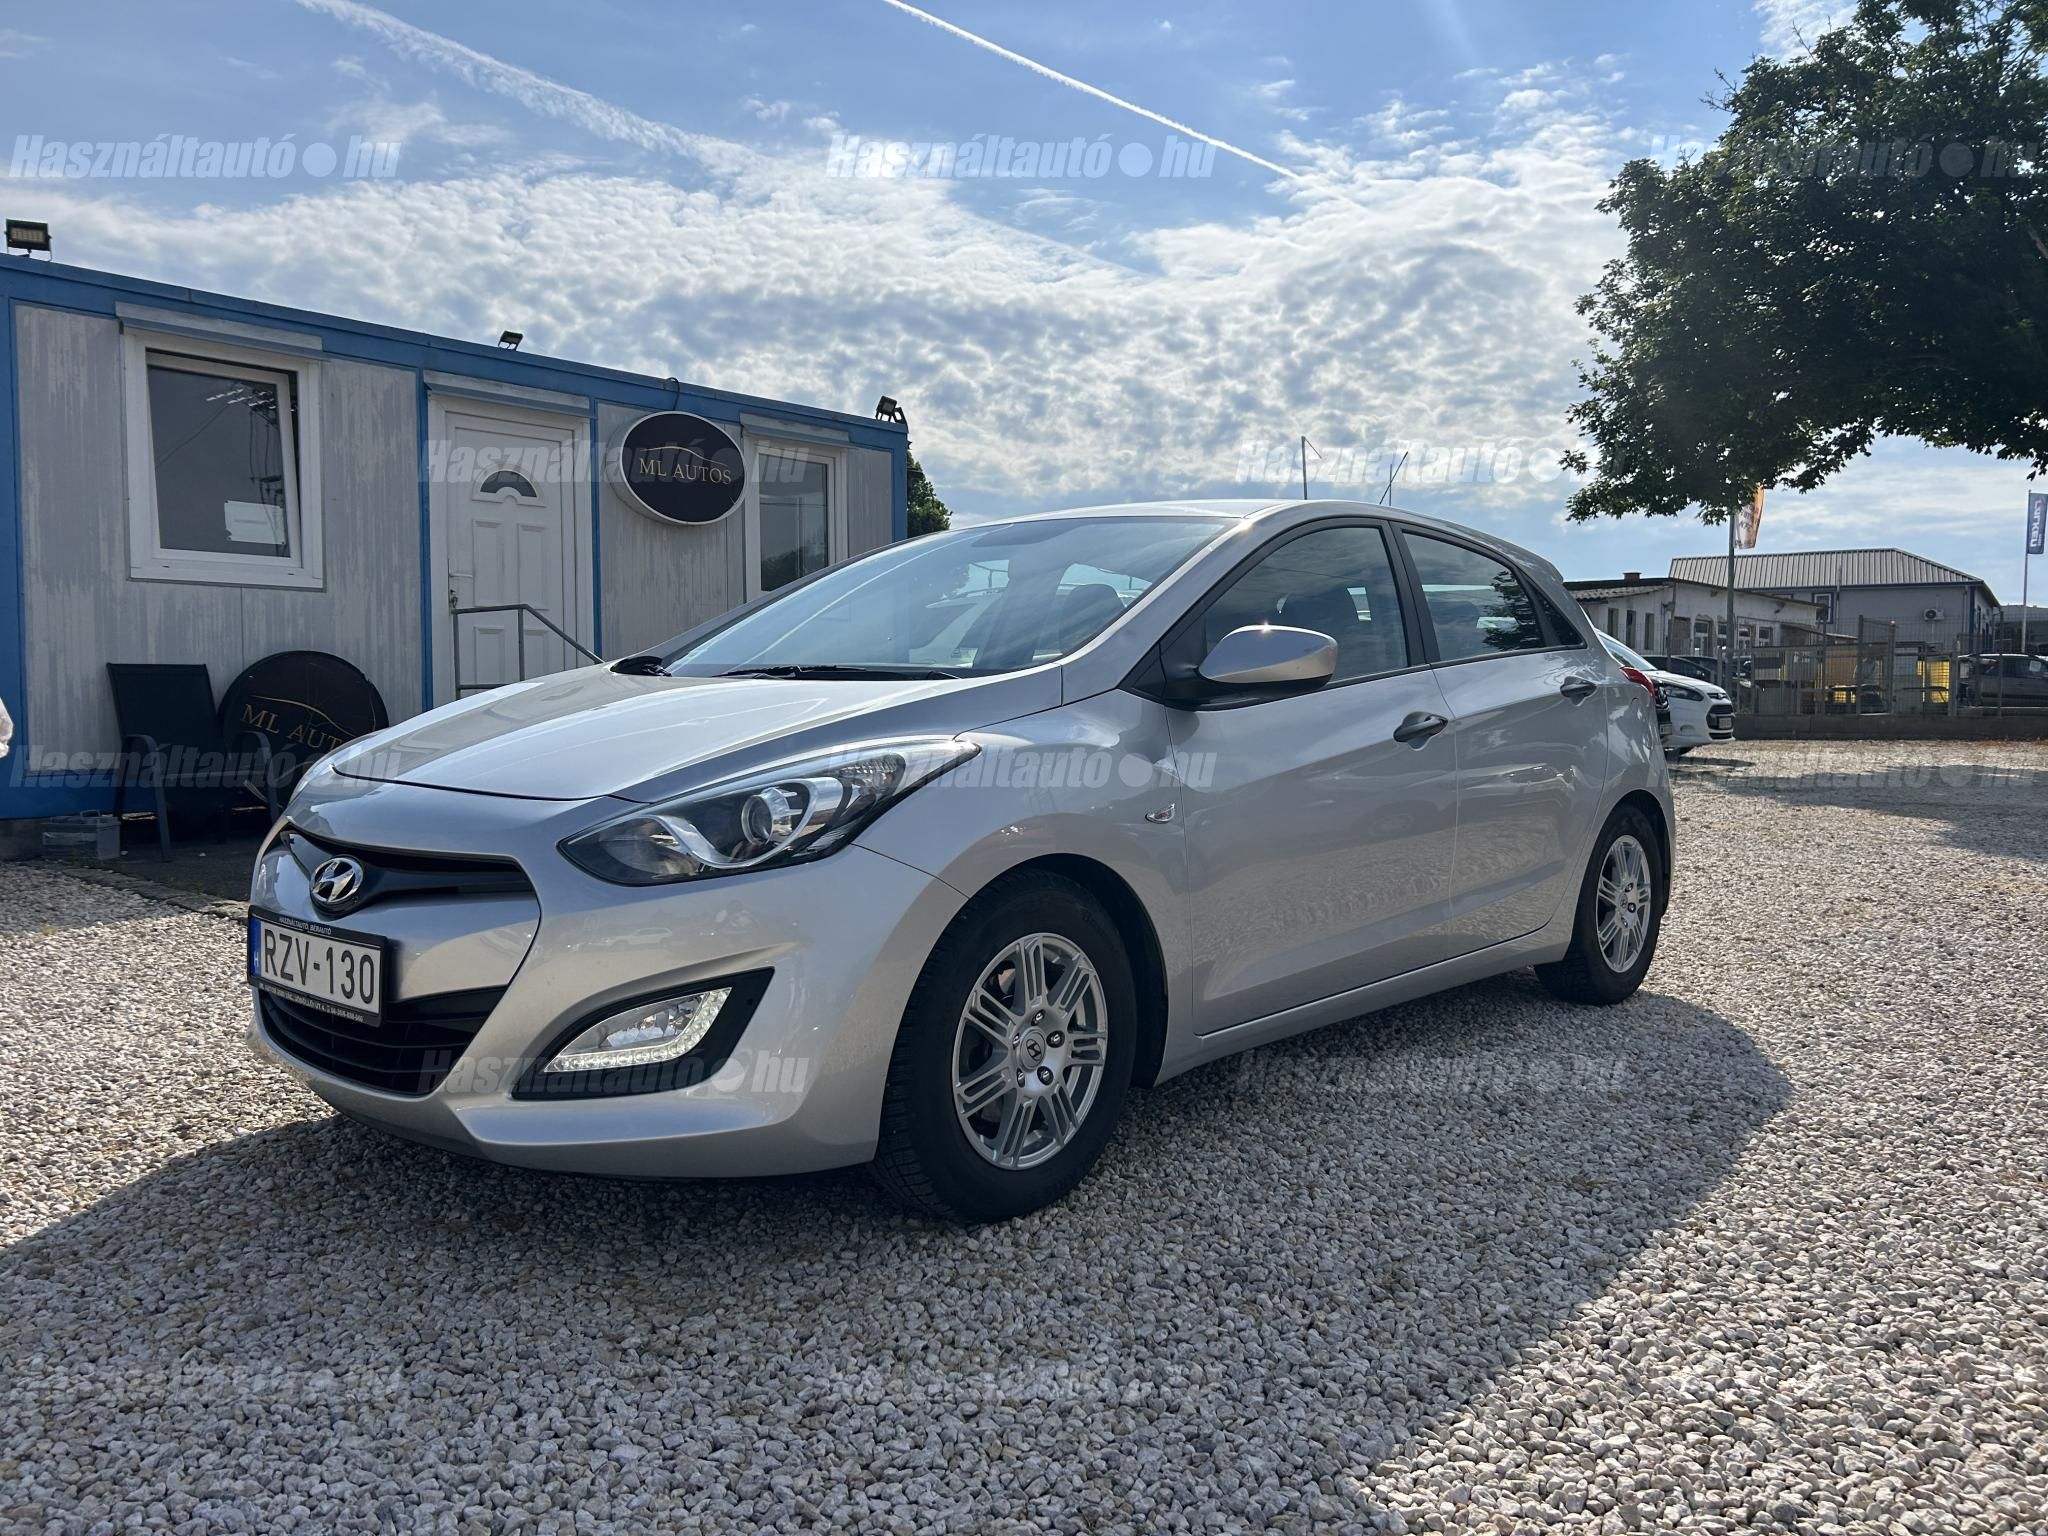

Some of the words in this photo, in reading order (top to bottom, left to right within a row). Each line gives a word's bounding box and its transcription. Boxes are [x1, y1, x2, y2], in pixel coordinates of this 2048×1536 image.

[640, 458, 667, 477] ML
[673, 464, 732, 485] AUTOS
[241, 703, 280, 734] ML
[288, 724, 343, 751] AUT
[264, 928, 375, 1005] RZV-130
